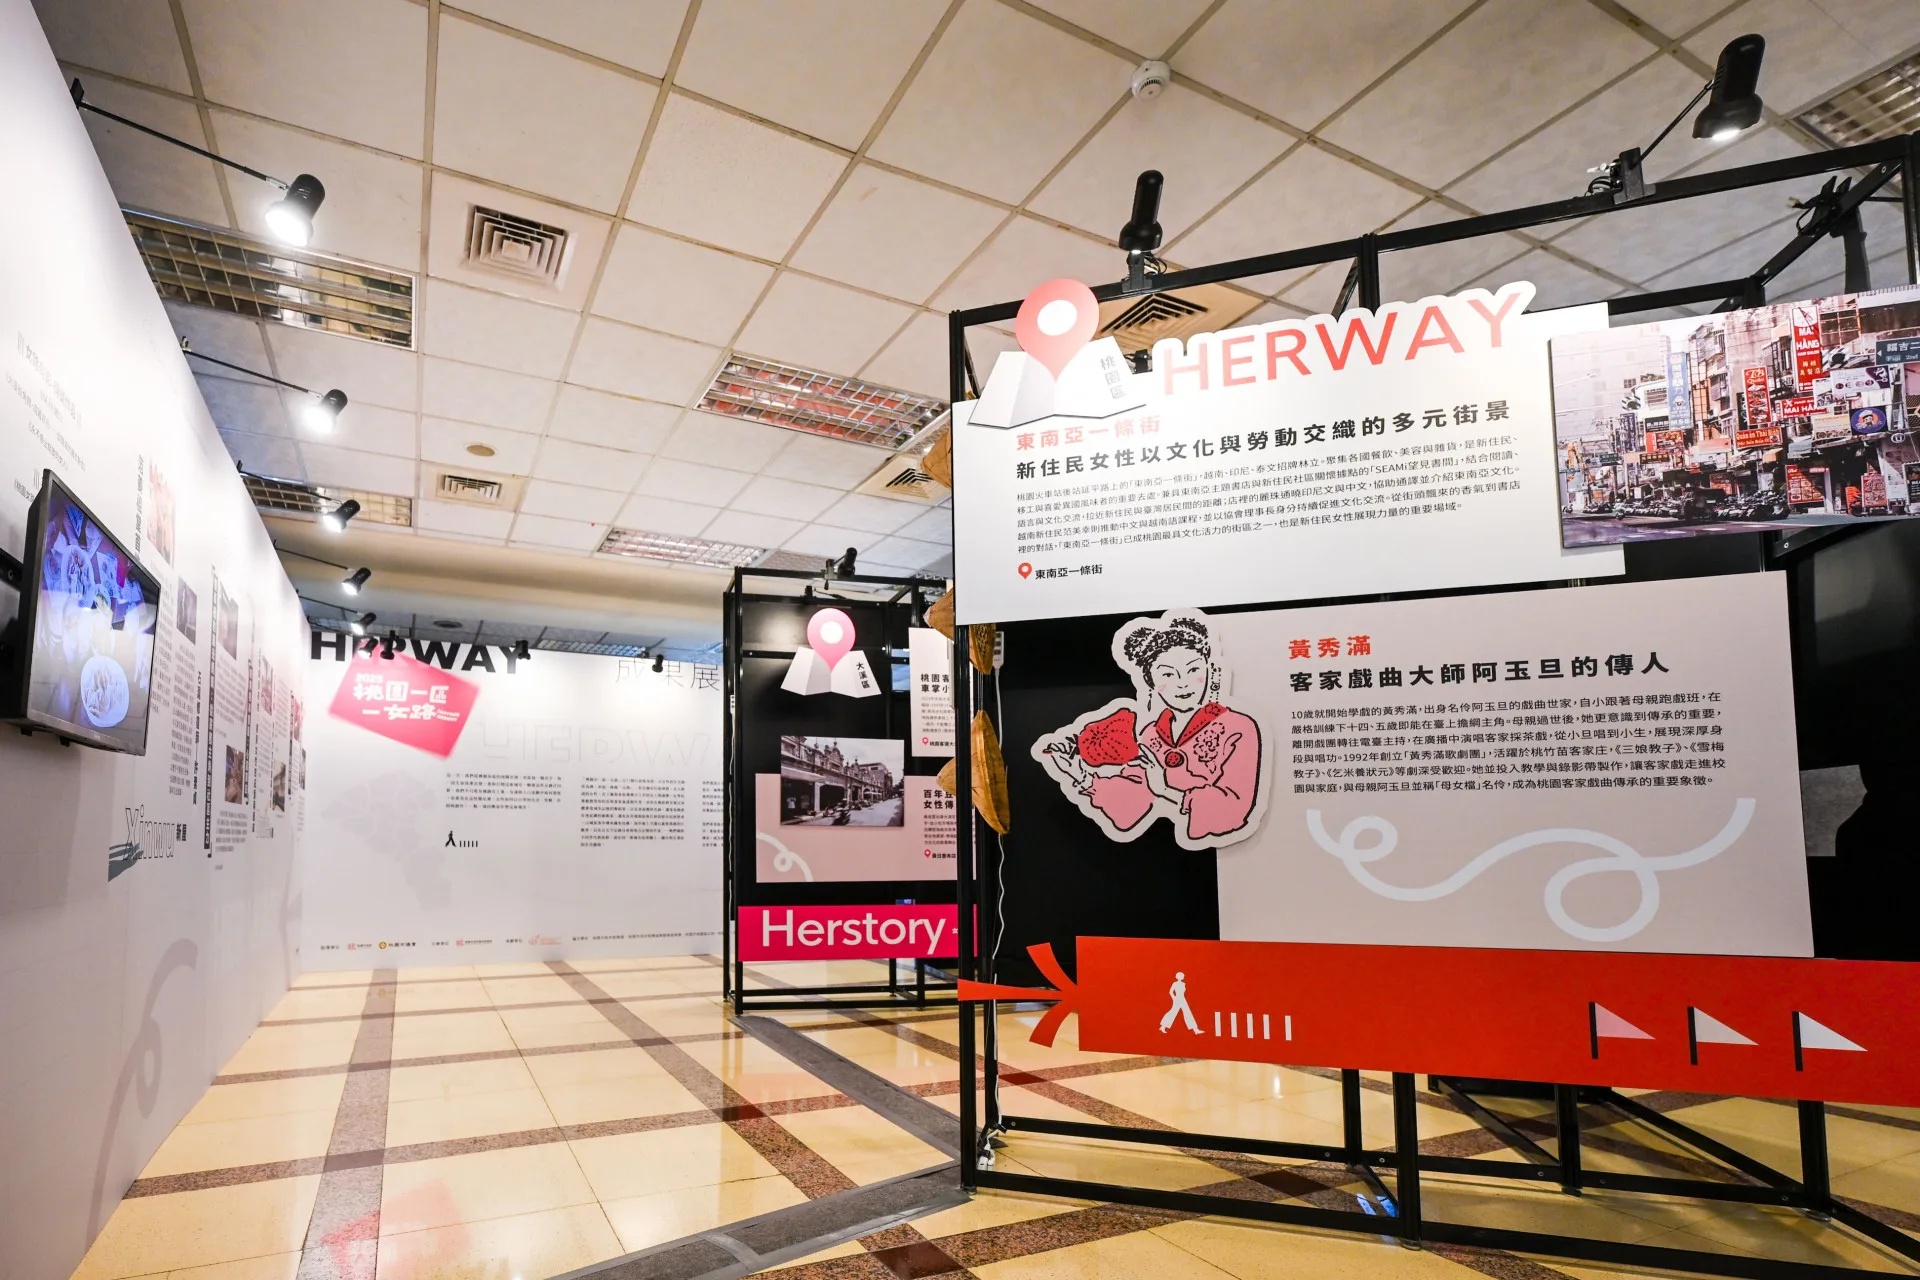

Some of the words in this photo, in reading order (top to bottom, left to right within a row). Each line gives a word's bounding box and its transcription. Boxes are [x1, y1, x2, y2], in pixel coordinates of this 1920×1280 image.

[1163, 292, 1522, 397] HERWAY
[1100, 355, 1127, 400] 桃園區
[1016, 414, 1160, 451] 東南亞一條街
[1016, 400, 1510, 479] 新住民女性以文化與勞動交織的多元街景
[1035, 564, 1103, 580] 東南亞一條街
[1288, 635, 1371, 660] 黃秀滿
[856, 661, 871, 689] 大溪區
[921, 673, 950, 683] 桃園客
[1289, 651, 1670, 693] 客家戲曲大師阿玉旦的傳人
[353, 681, 449, 704] 桃園一區
[362, 703, 437, 720] 一女路
[923, 800, 954, 810] 女性傳
[762, 909, 946, 955] Herstory
